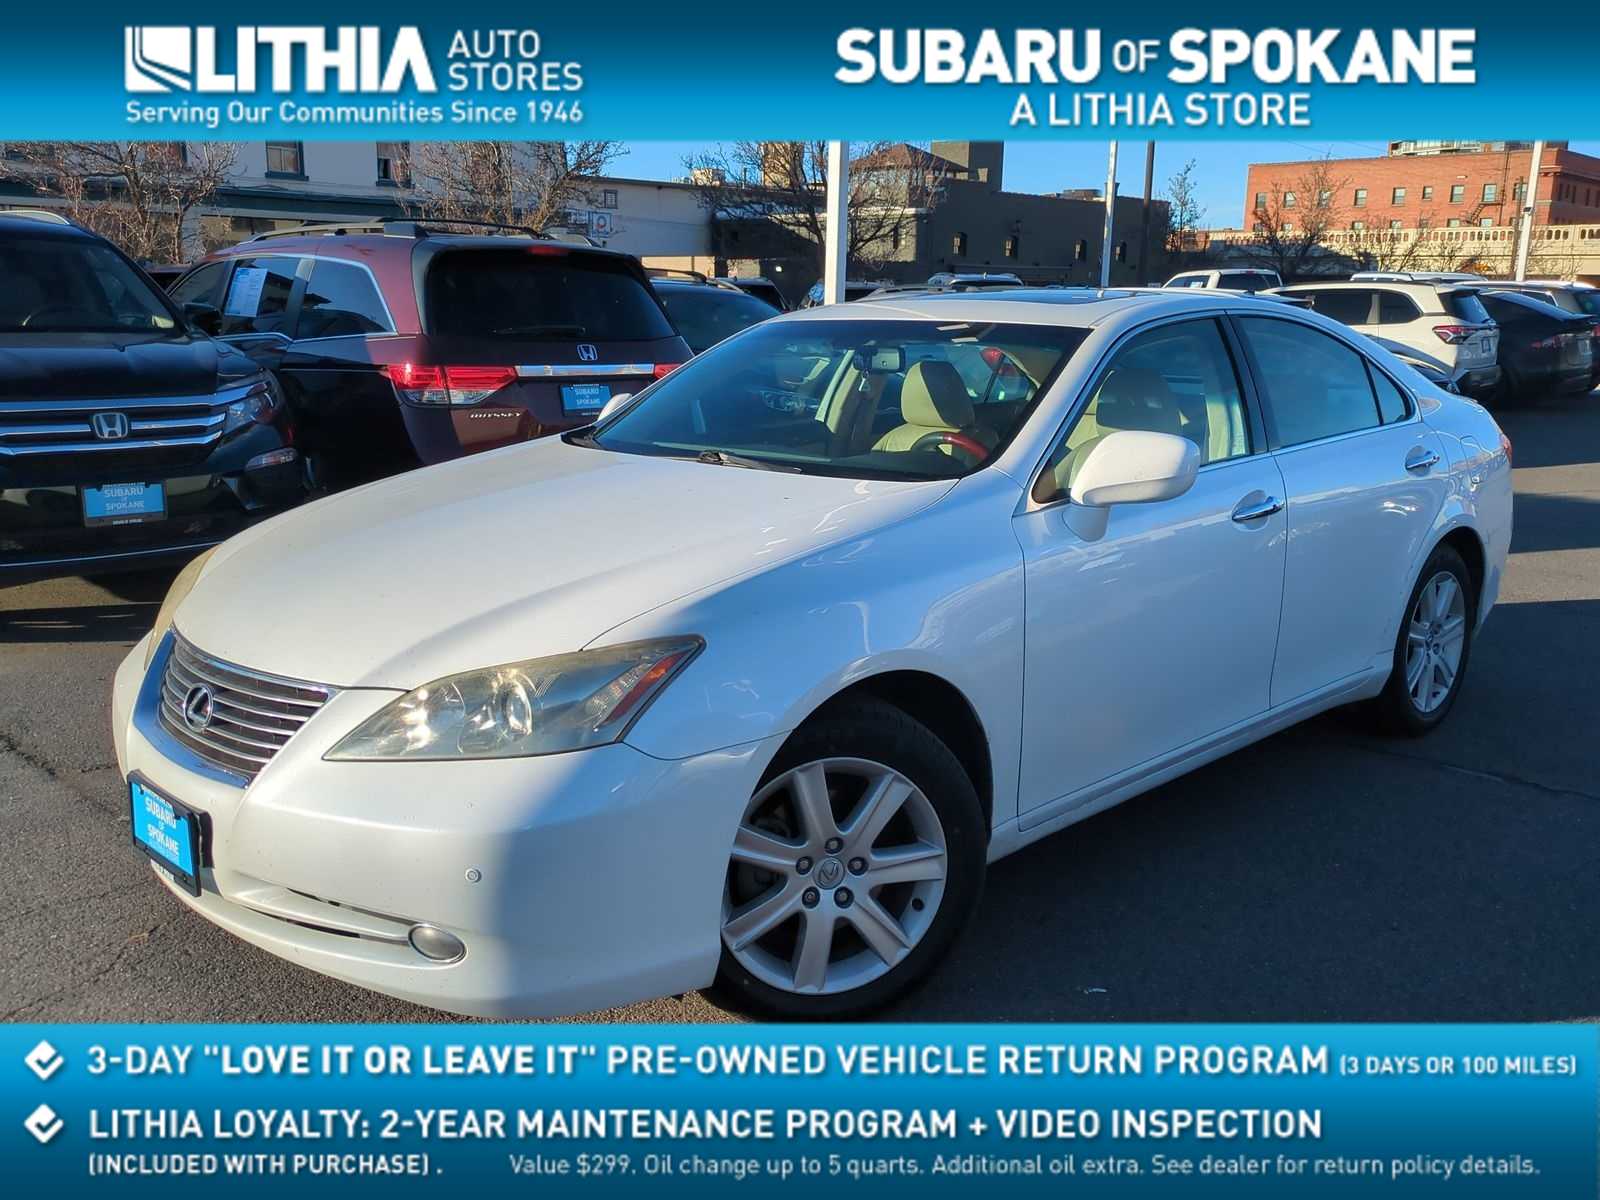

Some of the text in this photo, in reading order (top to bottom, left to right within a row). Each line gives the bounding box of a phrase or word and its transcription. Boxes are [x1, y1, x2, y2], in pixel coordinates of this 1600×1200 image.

[103, 486, 144, 498] SUBARU
[105, 500, 145, 511] SPOKANE
[145, 797, 177, 830] SUBARU
[147, 823, 179, 853] SPOKANE
